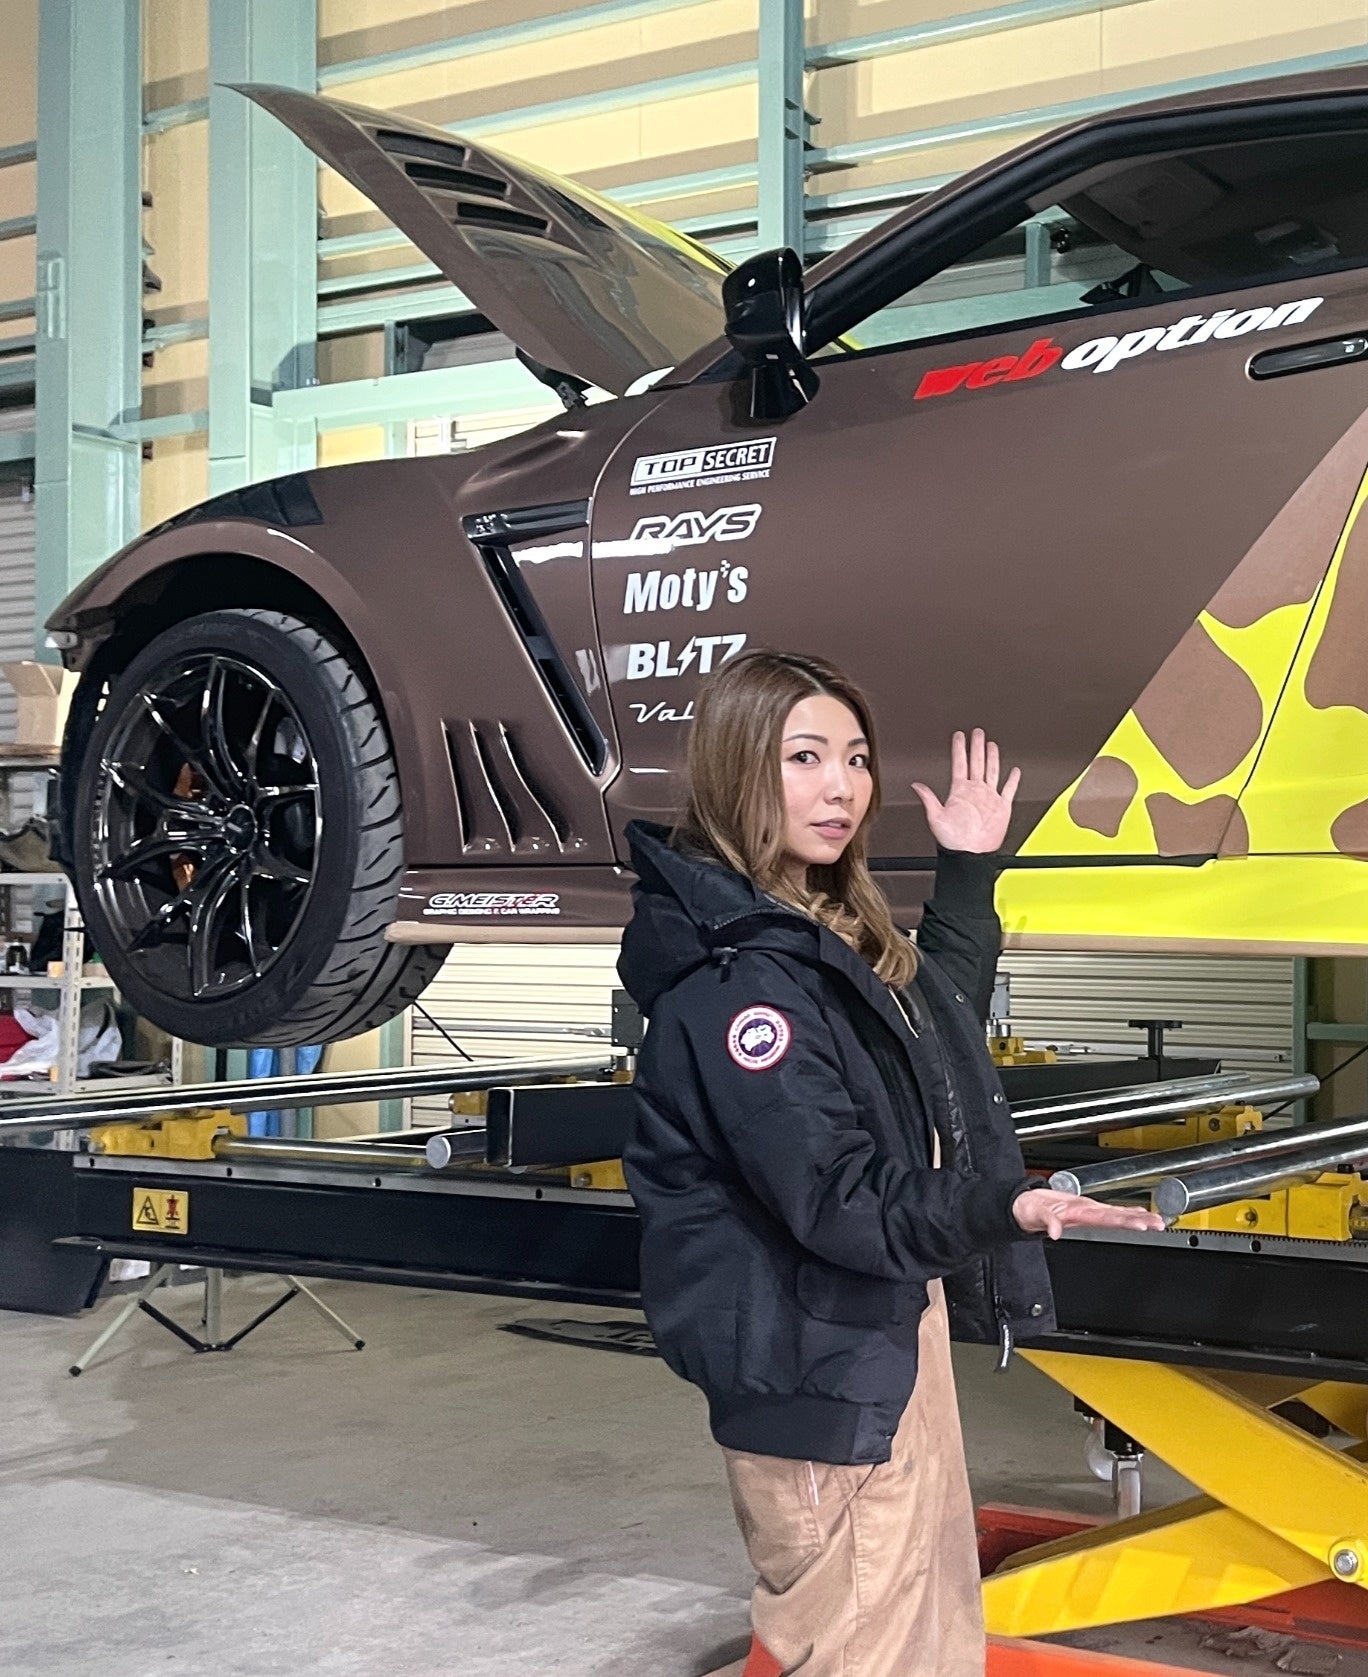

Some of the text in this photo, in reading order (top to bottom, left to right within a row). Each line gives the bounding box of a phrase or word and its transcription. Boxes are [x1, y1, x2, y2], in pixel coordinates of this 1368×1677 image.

[645, 443, 770, 476] TOP SECRET
[647, 479, 696, 494] PERFORMANCE
[696, 473, 741, 487] ENGINEERING
[742, 469, 770, 481] SERVICE
[630, 504, 761, 546] RAYS
[623, 560, 749, 614] Moty's
[629, 701, 695, 723] Val
